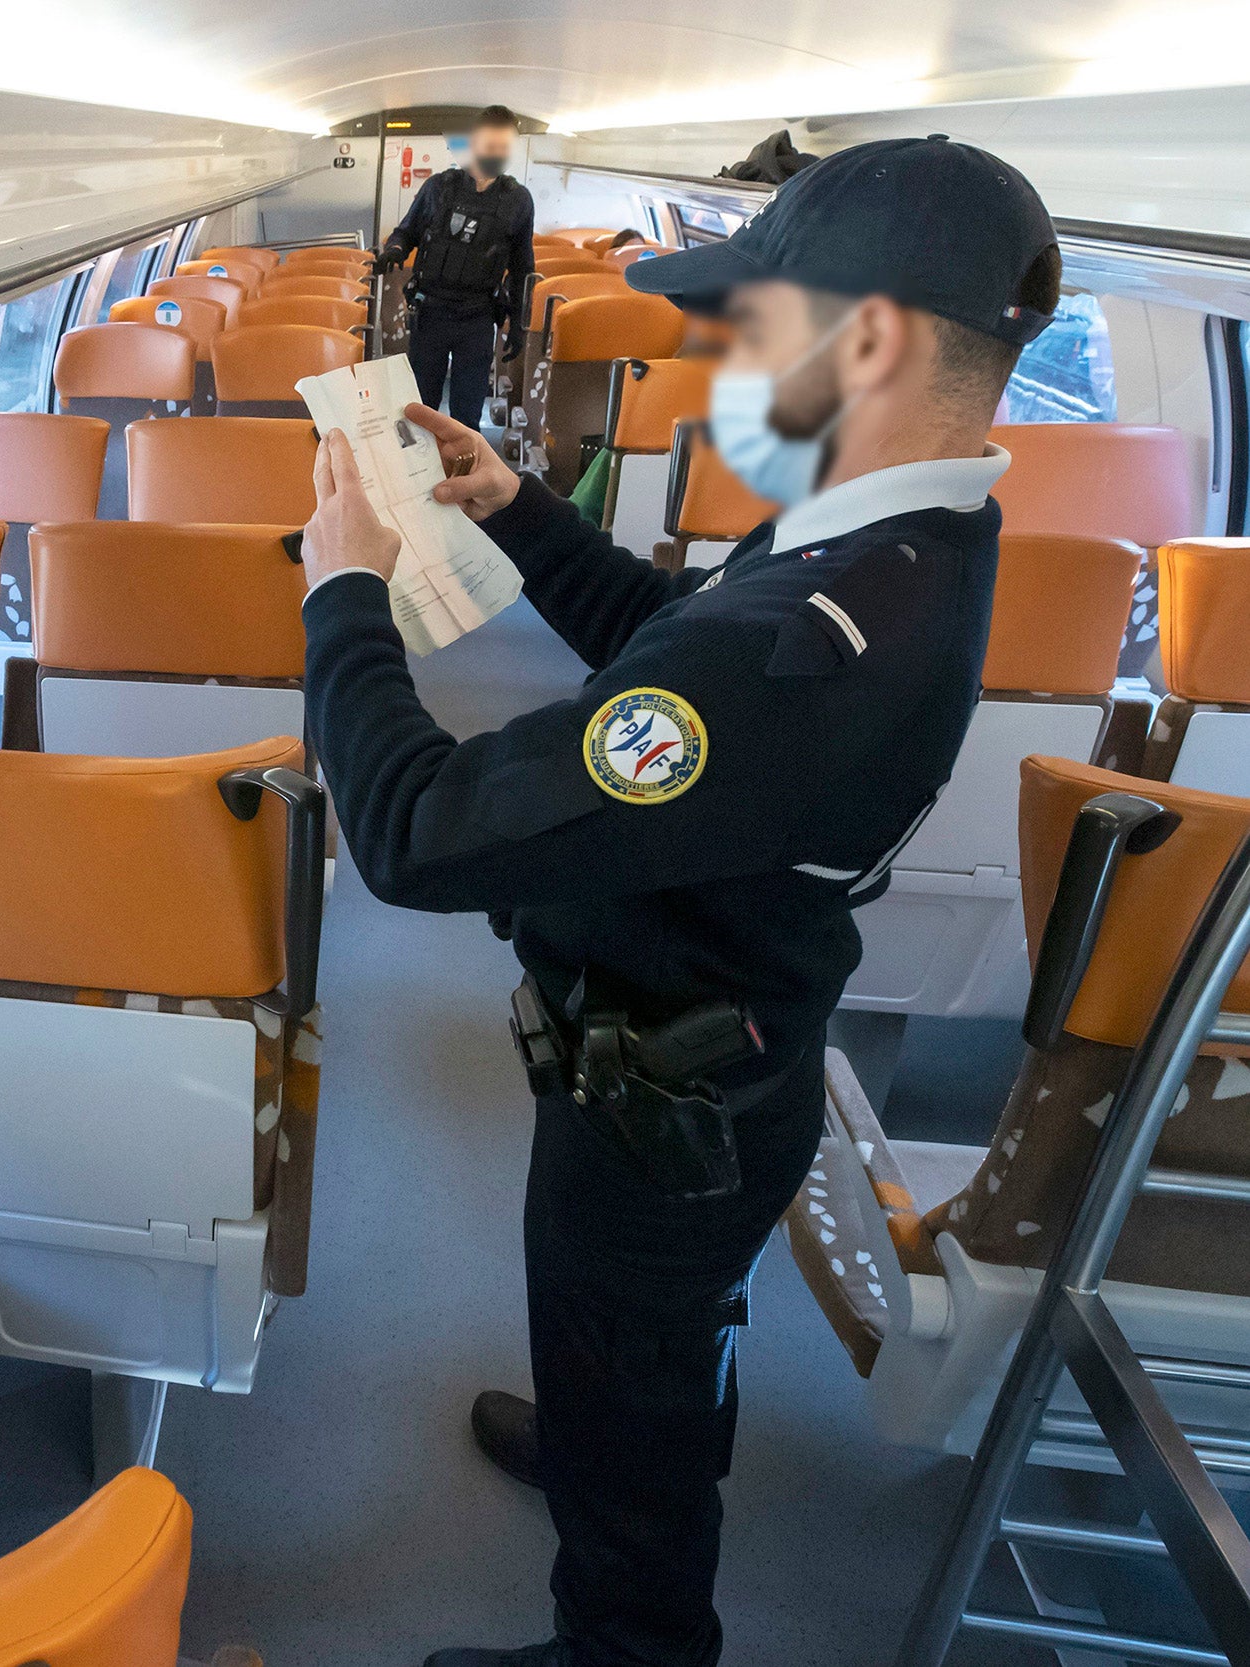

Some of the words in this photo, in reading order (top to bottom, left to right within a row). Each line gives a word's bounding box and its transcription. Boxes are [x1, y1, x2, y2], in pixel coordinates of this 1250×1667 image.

[618, 721, 671, 769] PAF
[640, 703, 672, 715] POLICE
[669, 710, 692, 756] NATIONALE
